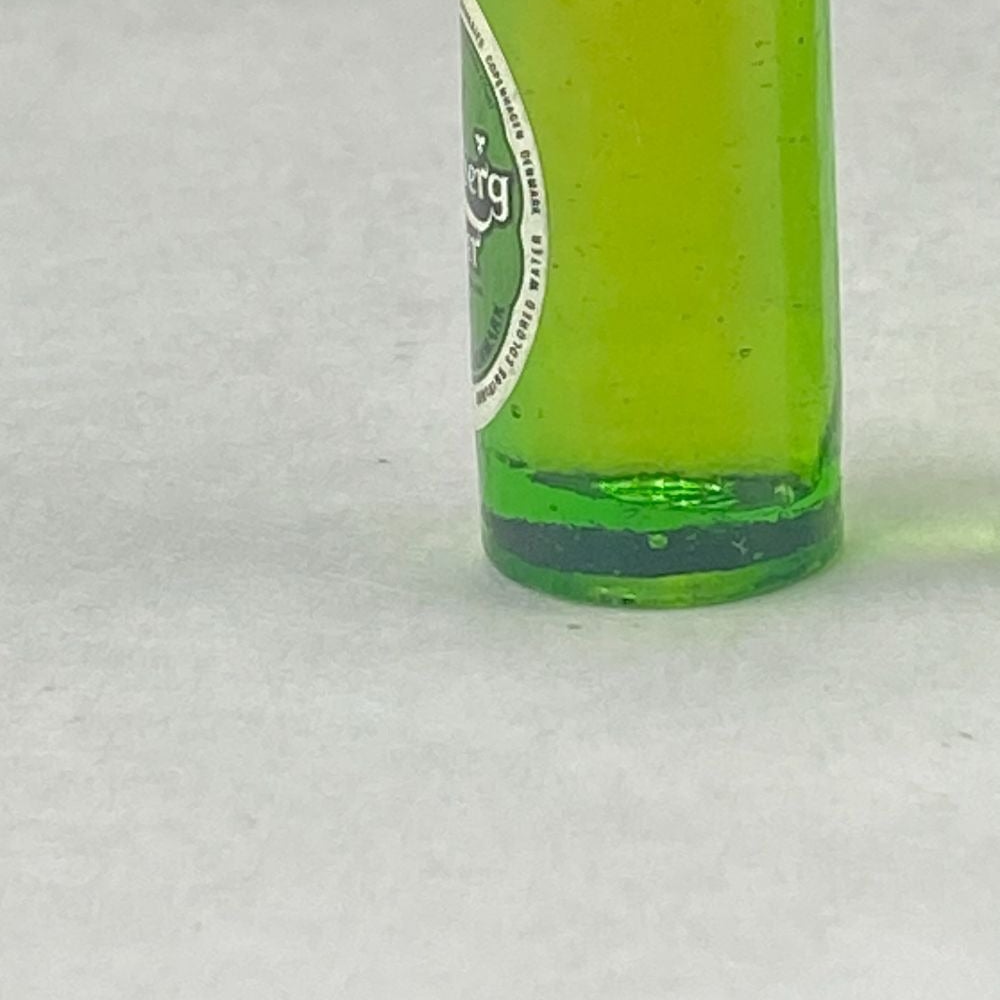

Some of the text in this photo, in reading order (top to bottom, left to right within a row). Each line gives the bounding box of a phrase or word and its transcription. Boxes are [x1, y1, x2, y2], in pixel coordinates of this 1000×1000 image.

[519, 149, 542, 216] DENMARK
[504, 234, 545, 368] COLORED WATER
